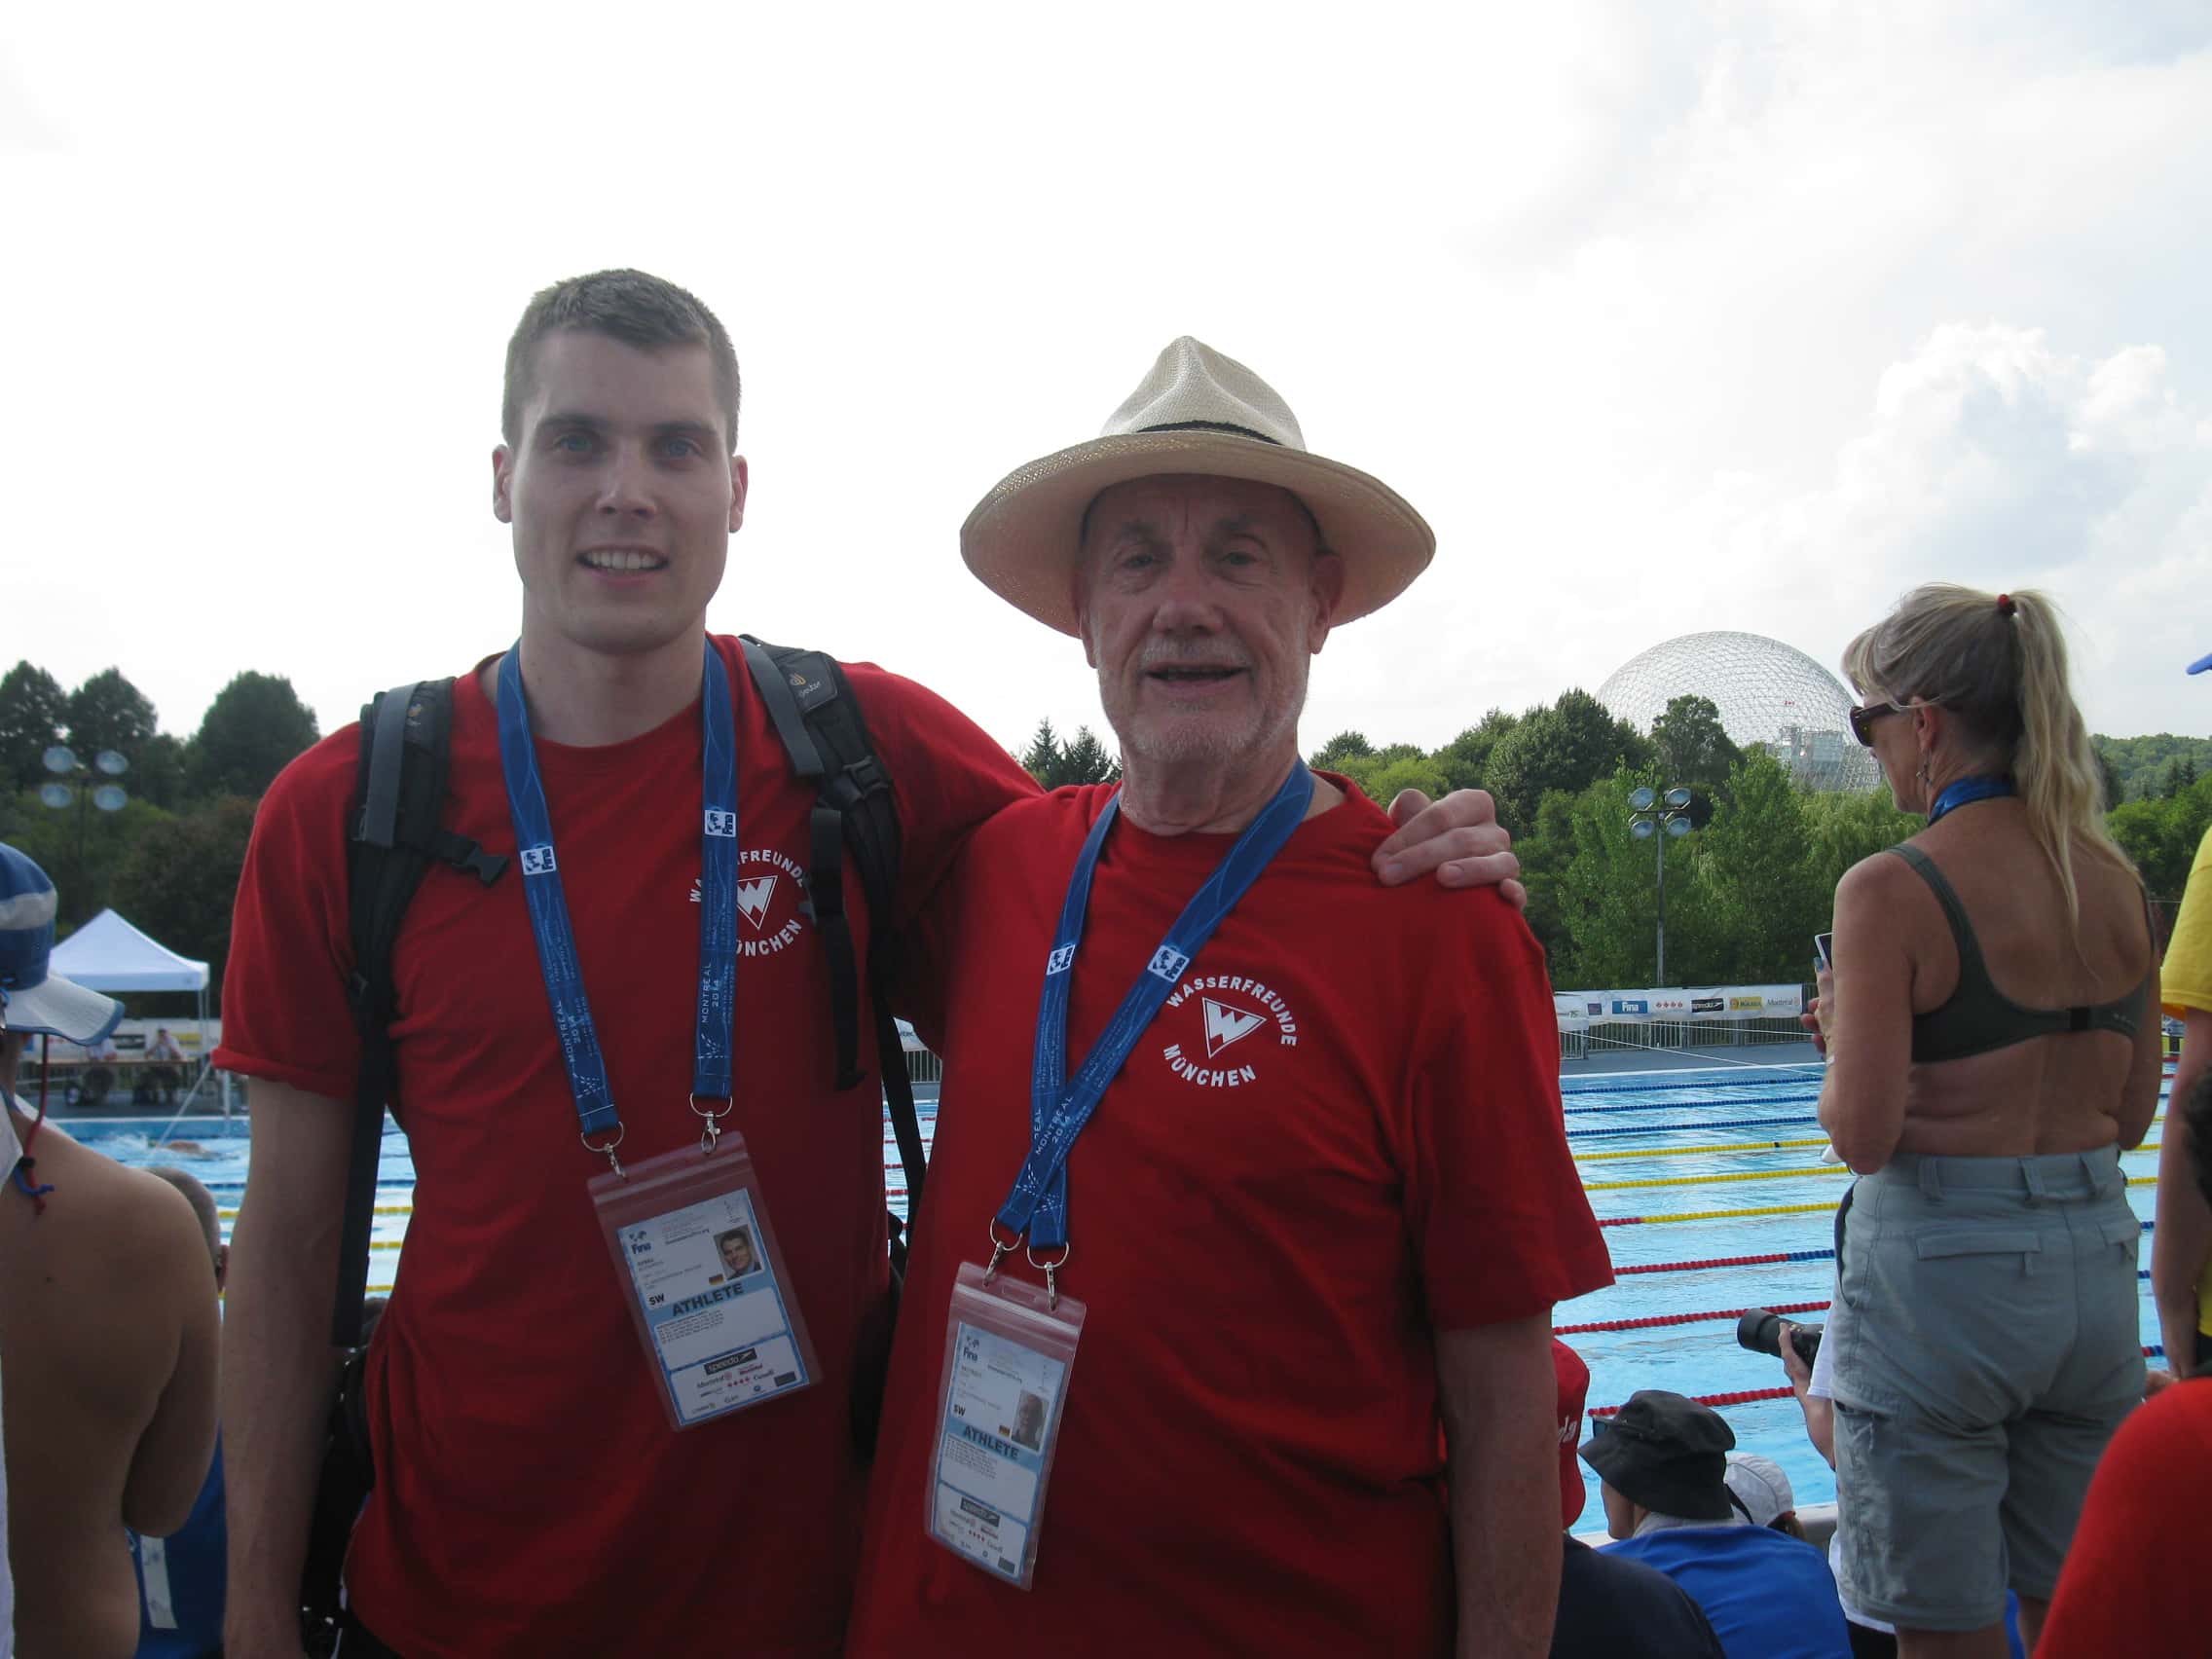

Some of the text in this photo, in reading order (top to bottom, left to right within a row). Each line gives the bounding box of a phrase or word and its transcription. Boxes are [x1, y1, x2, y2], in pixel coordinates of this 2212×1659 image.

[737, 919, 802, 956] NCHEN
[1166, 976, 1297, 1047] WASSERFREUNDE
[1162, 1044, 1256, 1088] MÜNCHEN
[1035, 1096, 1074, 1155] MONTREAL
[648, 1294, 665, 1306] SW
[672, 1282, 745, 1317] ATHLETE
[953, 1404, 966, 1417] SW
[962, 1425, 1020, 1460] ATHLETE
